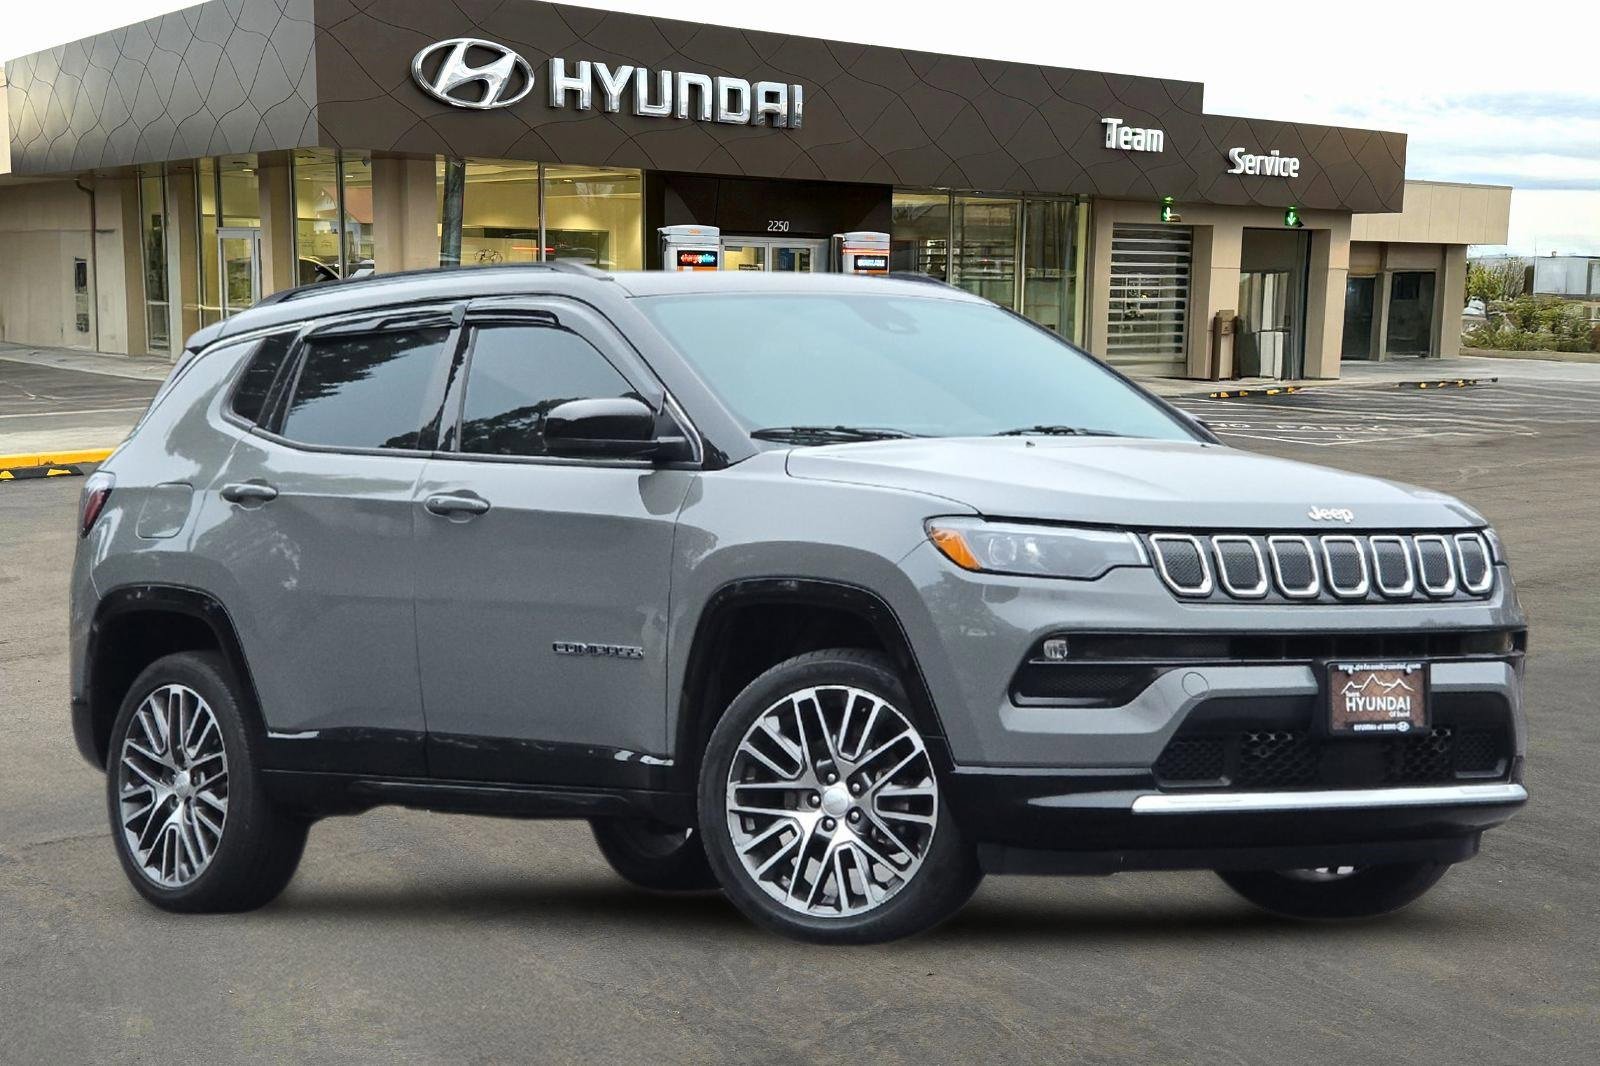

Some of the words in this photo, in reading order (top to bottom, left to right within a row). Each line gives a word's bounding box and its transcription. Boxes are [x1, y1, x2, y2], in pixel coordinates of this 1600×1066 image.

[549, 57, 803, 129] HYUNDAI
[1101, 117, 1164, 153] Team
[1227, 147, 1300, 178] Service
[767, 220, 790, 232] 2250
[1307, 505, 1354, 524] Jeep
[1345, 696, 1411, 712] HYUNDAI
